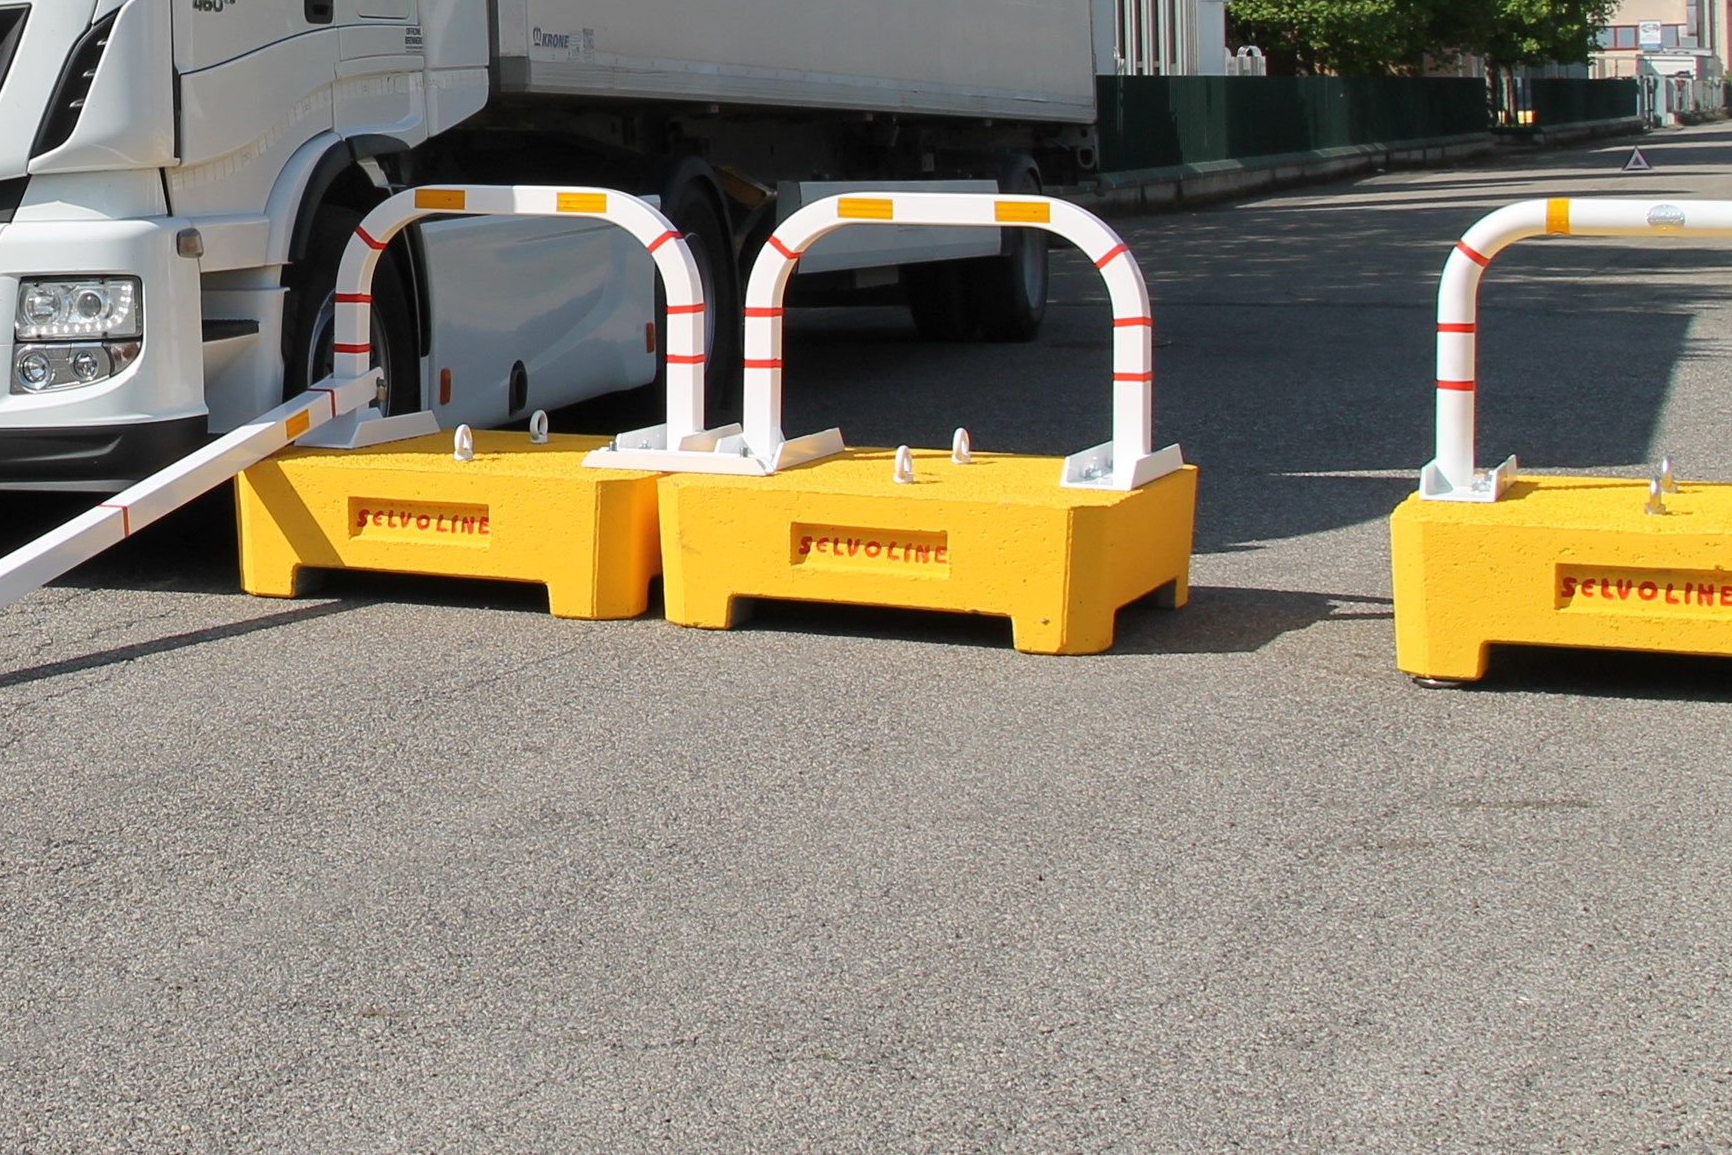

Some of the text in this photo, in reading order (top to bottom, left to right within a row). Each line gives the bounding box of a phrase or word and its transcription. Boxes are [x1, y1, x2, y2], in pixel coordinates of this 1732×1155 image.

[542, 32, 570, 49] KRONE
[356, 508, 490, 535] SELVOLINE
[798, 535, 948, 564] SELVOLINE
[1560, 576, 1732, 607] SELVOLINE
